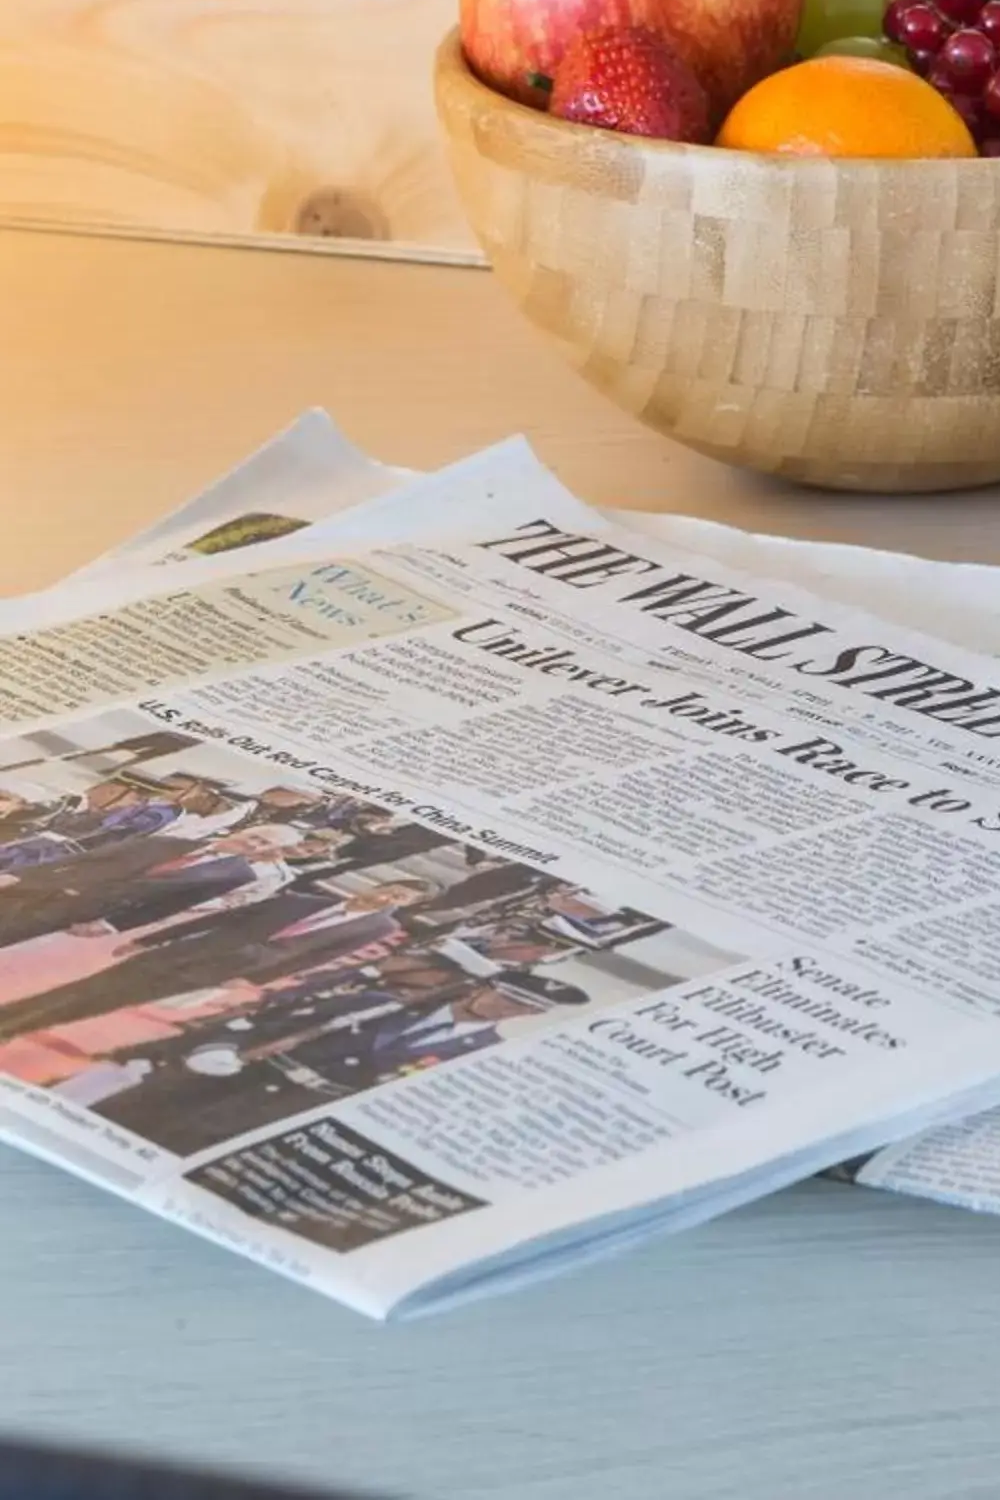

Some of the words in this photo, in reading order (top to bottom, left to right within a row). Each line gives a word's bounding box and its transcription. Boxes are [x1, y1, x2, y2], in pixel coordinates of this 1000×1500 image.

[273, 579, 366, 627] News
[312, 564, 428, 623] What's
[474, 518, 664, 589] THE
[616, 573, 837, 661] WALL
[452, 618, 651, 696] Unilever
[640, 692, 783, 742] Joins
[774, 736, 909, 792] Race
[908, 789, 972, 813] to
[138, 699, 182, 723] U.S.
[177, 719, 231, 740] Rolls
[227, 735, 272, 756] Out
[265, 750, 318, 770] Red
[307, 766, 382, 802] Carpet
[376, 791, 416, 808] for
[411, 804, 474, 835] China
[470, 829, 561, 866] Summit
[727, 969, 907, 1050] Eliminates
[776, 955, 892, 1010] Senate
[633, 1001, 699, 1032] For
[694, 1026, 786, 1075] High
[680, 985, 847, 1060] Filibuster
[587, 1017, 689, 1067] Court
[683, 1060, 768, 1107] Post
